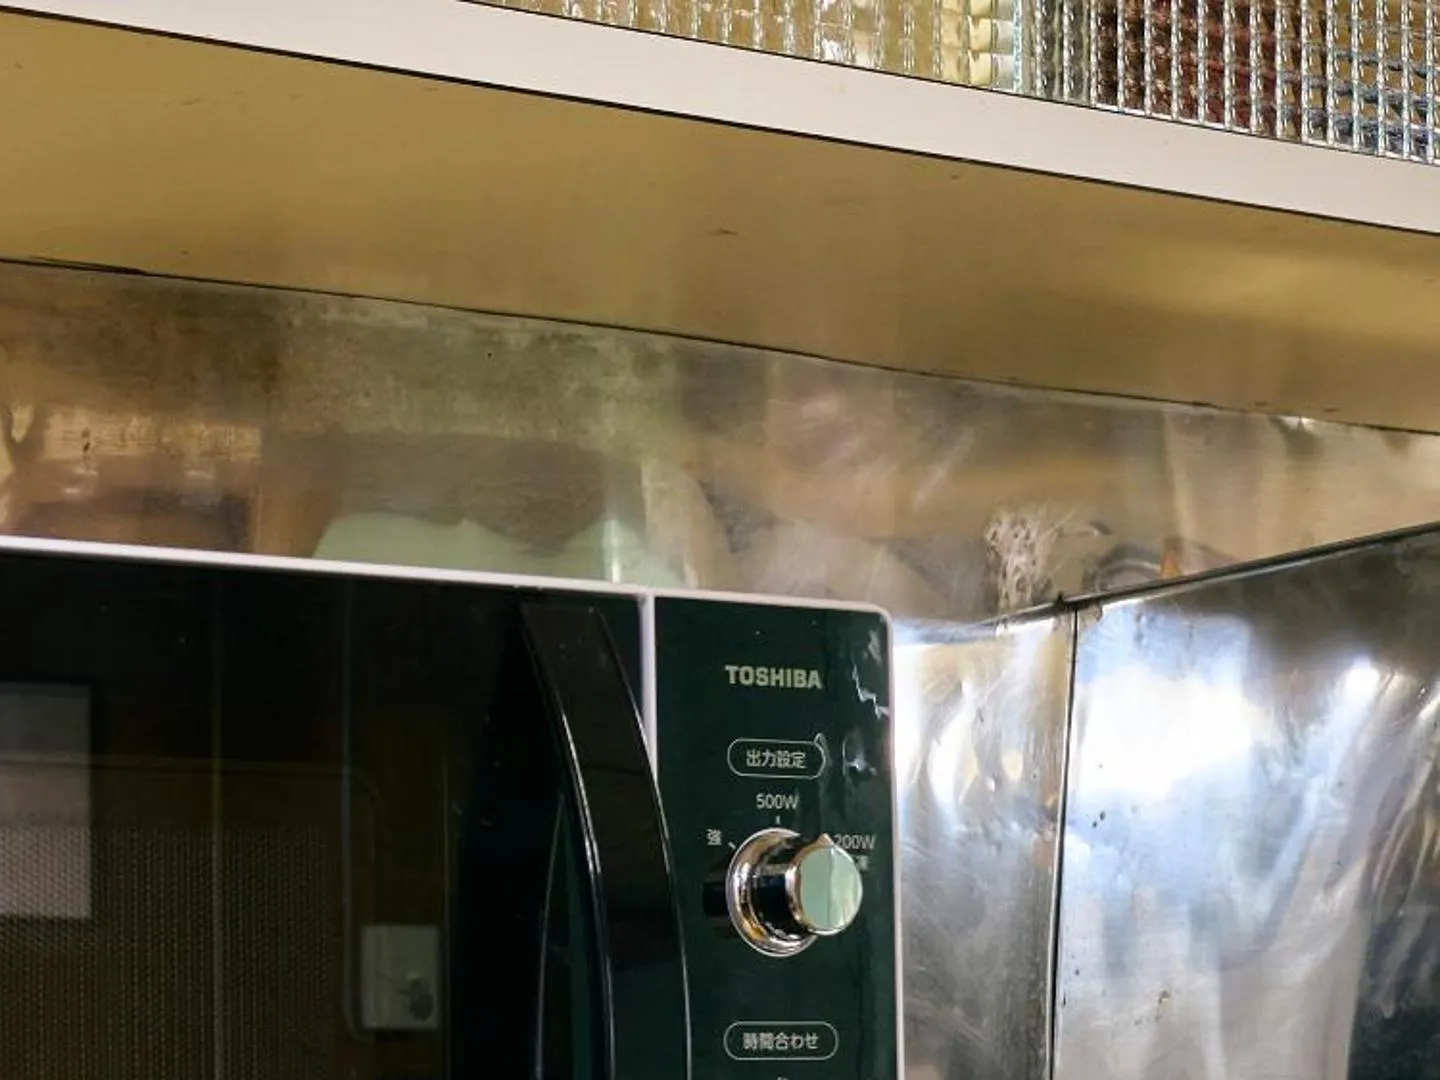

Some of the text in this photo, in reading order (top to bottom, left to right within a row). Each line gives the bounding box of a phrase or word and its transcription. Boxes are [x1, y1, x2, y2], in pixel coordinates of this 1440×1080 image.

[725, 665, 823, 689] TOSHIBA
[746, 749, 807, 768] 出力設定
[756, 794, 799, 809] 500W
[742, 1032, 819, 1050] 時間合わせ
